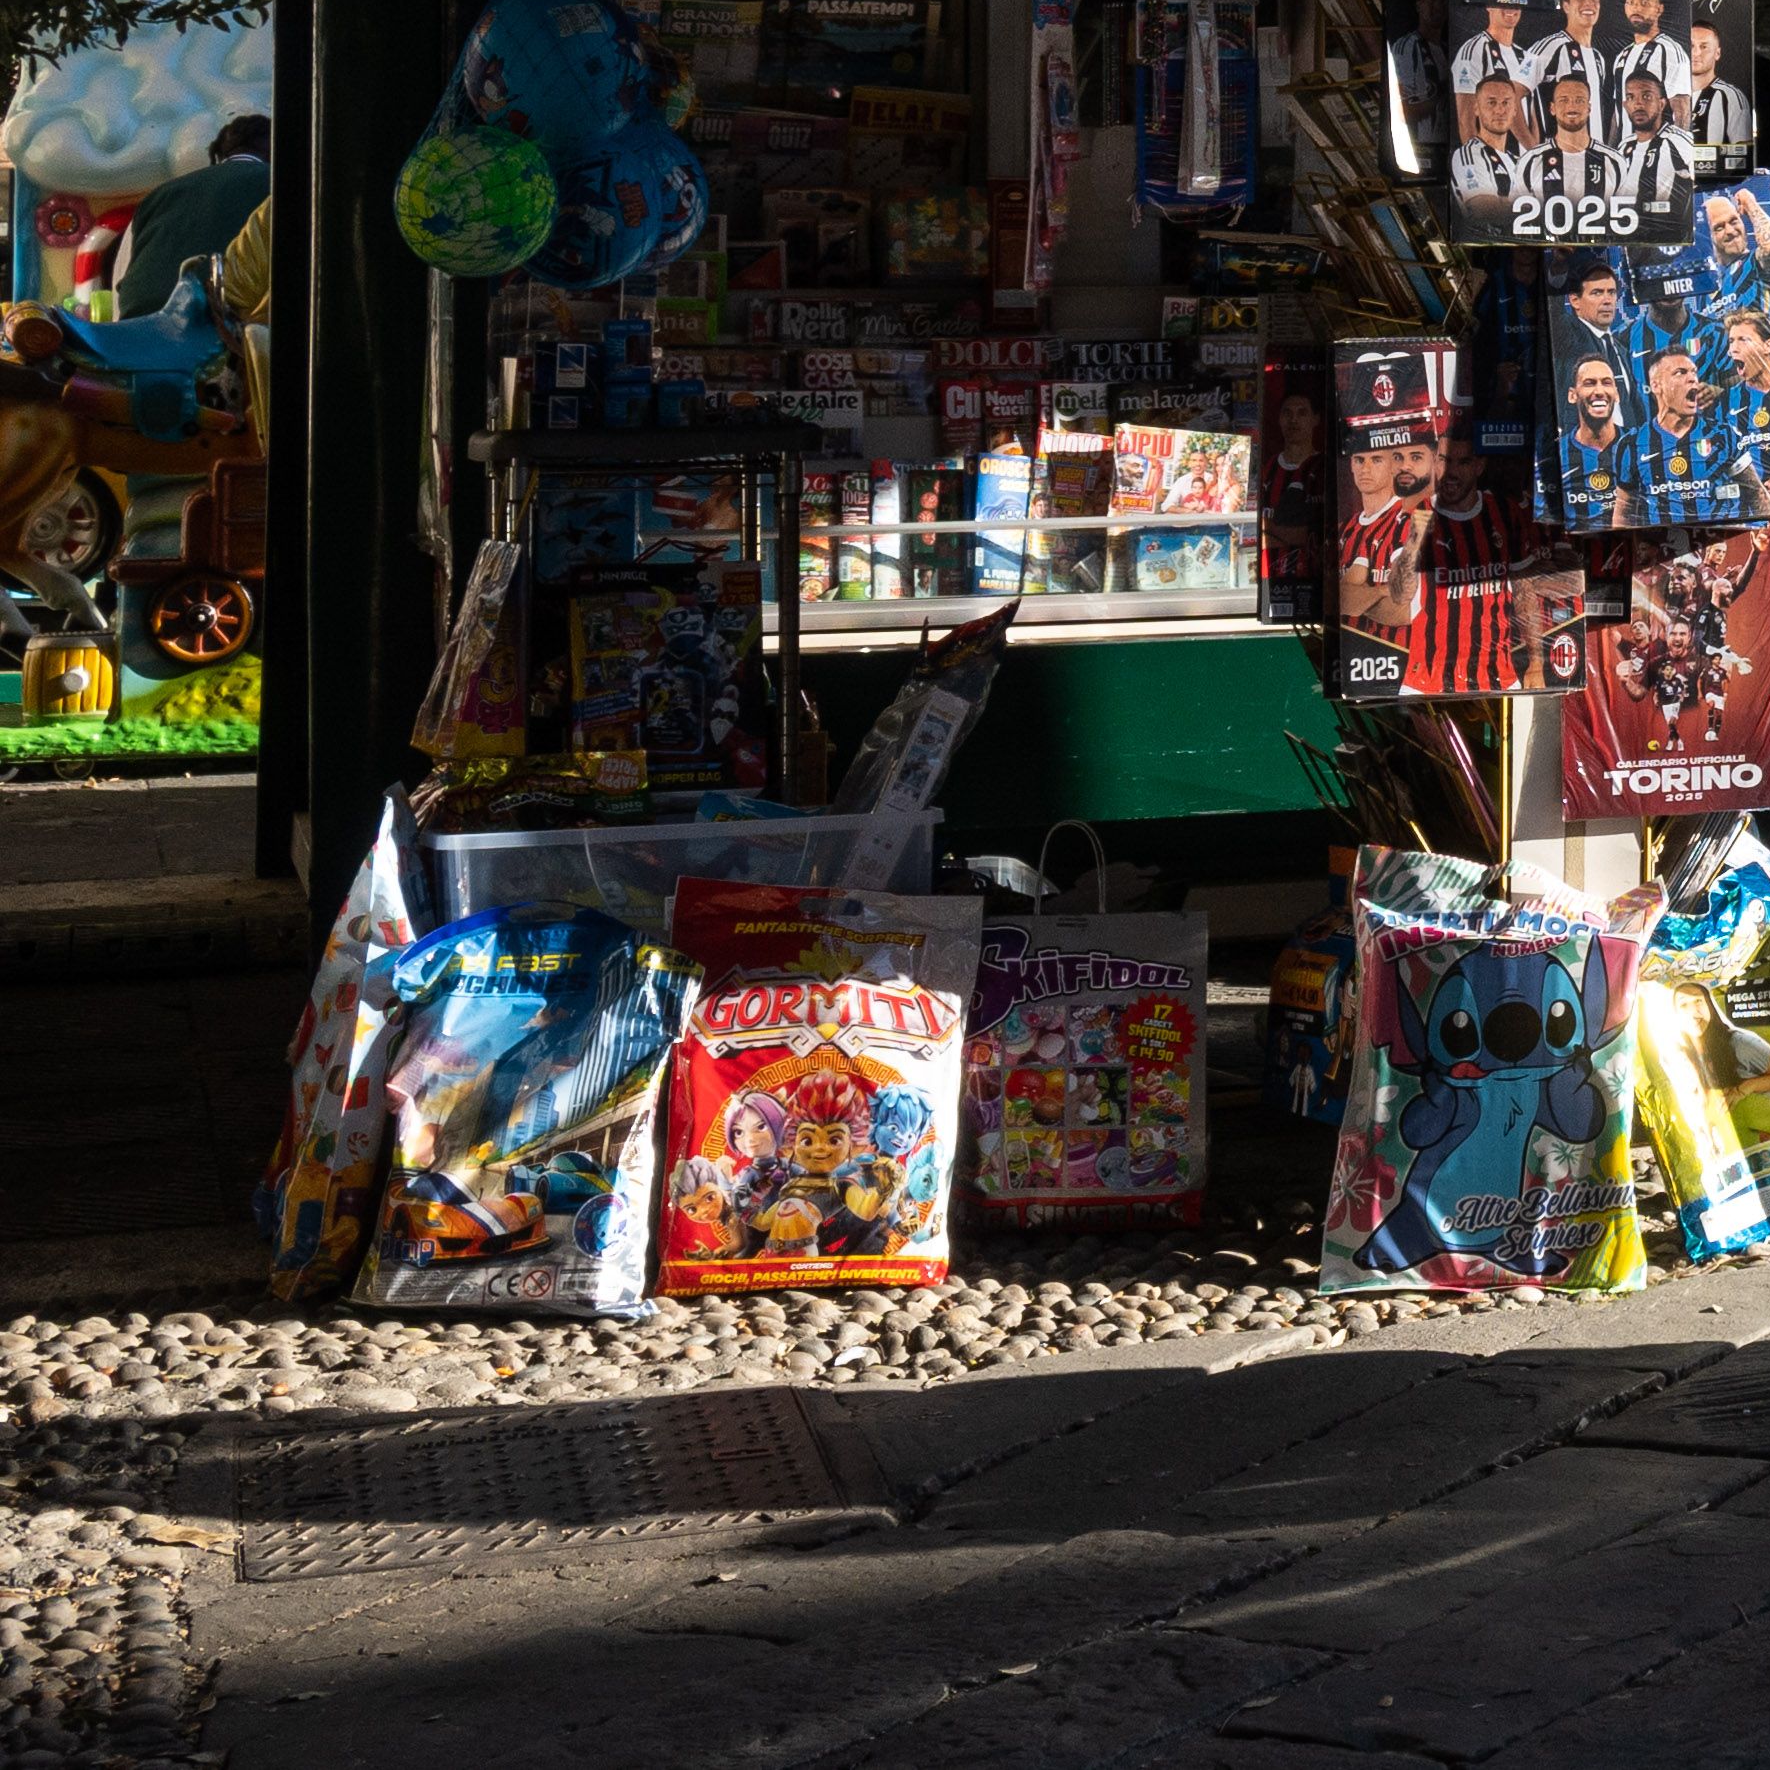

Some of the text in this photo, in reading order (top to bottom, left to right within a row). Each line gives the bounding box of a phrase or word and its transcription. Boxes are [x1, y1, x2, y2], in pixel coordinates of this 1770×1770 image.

[807, 0, 915, 17] PASSATEMPI
[1511, 195, 1640, 236] 2025
[1663, 270, 1693, 296] INTER
[803, 353, 850, 371] COSE
[941, 339, 1042, 367] DOLCI
[1071, 341, 1174, 365] TORTE
[804, 371, 855, 389] CASA
[801, 392, 858, 410] claire
[1118, 386, 1232, 412] melaverde
[1042, 433, 1104, 453] NUOVO
[1370, 431, 1412, 449] MILAN
[1650, 478, 1711, 497] betsson
[1435, 562, 1508, 583] Emirates
[1446, 581, 1503, 600] FLY BETTER
[1349, 656, 1399, 682] 2025
[1616, 754, 1746, 769] CALENDARIO UFFICIALE
[1603, 763, 1763, 796] TORINO
[1665, 792, 1703, 802] 2025
[734, 921, 924, 947] FANTASTICHE SORPRESE
[1727, 990, 1756, 1004] MEGA
[1734, 1002, 1747, 1011] PER
[703, 983, 945, 1037] GORMITI
[1153, 1003, 1173, 1020] 17
[1128, 1022, 1184, 1044] SKIFIDOL
[1452, 1195, 1525, 1232] Altre
[1494, 1219, 1602, 1261] Sorprese
[700, 1268, 921, 1286] GIOCHI, PASSATEMPI DIVERTENTI,
